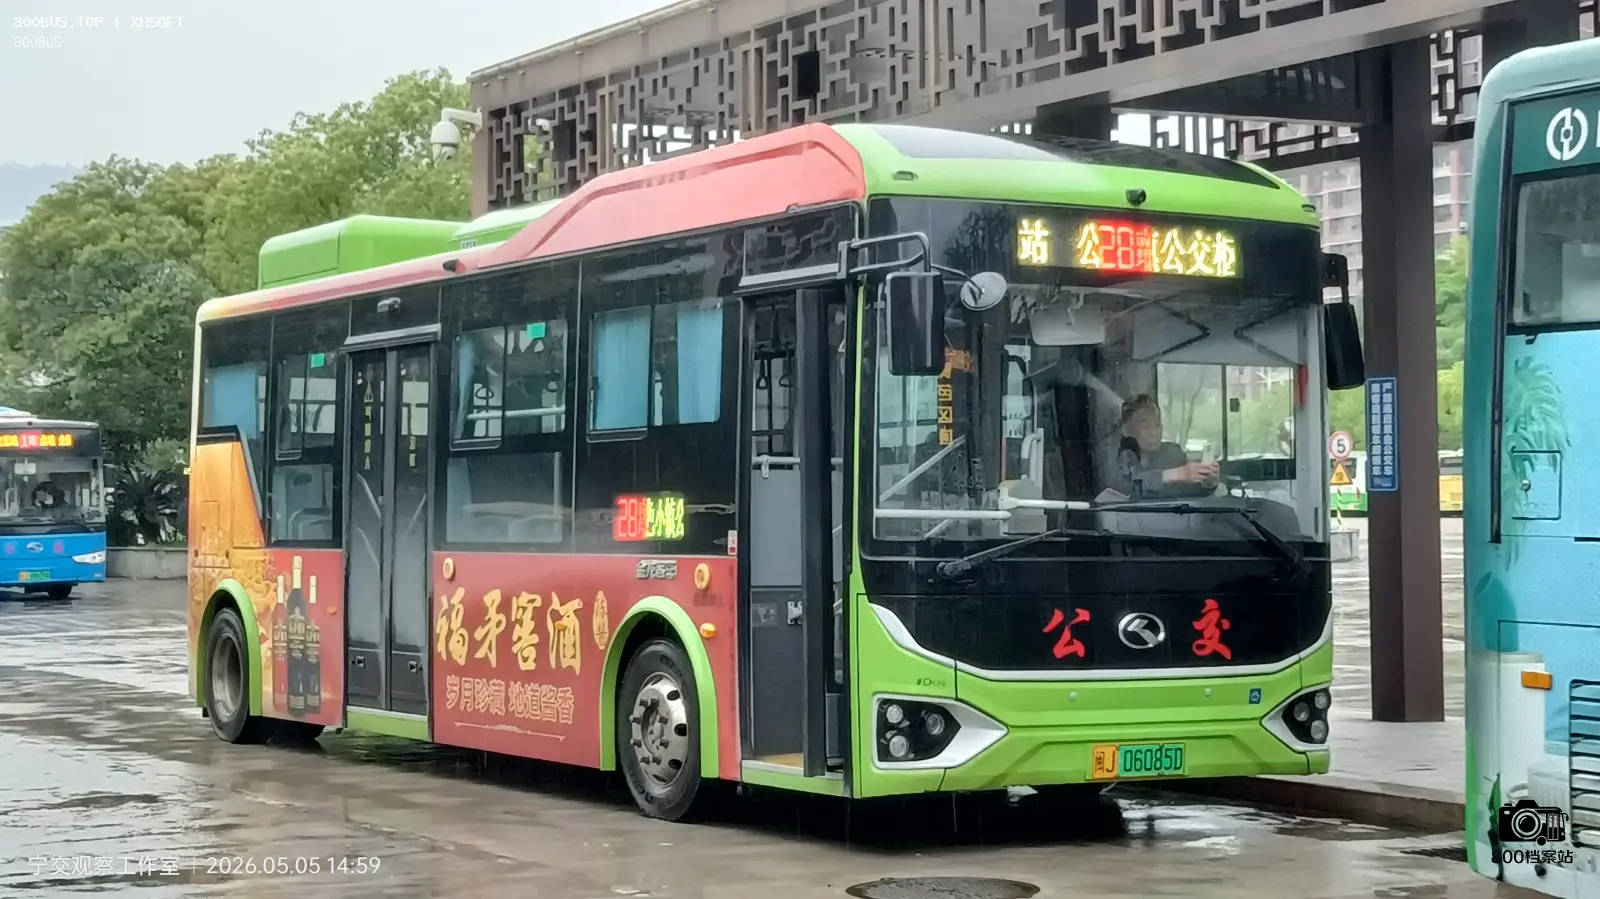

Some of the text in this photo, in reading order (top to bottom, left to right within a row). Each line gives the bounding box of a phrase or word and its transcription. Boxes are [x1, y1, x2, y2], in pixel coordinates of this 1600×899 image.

[1018, 219, 1050, 264] 站
[1336, 438, 1346, 454] 5
[618, 498, 637, 538] 28
[1042, 599, 1232, 660] 公 交
[446, 674, 574, 725] 岁月珍藏 地道酱香
